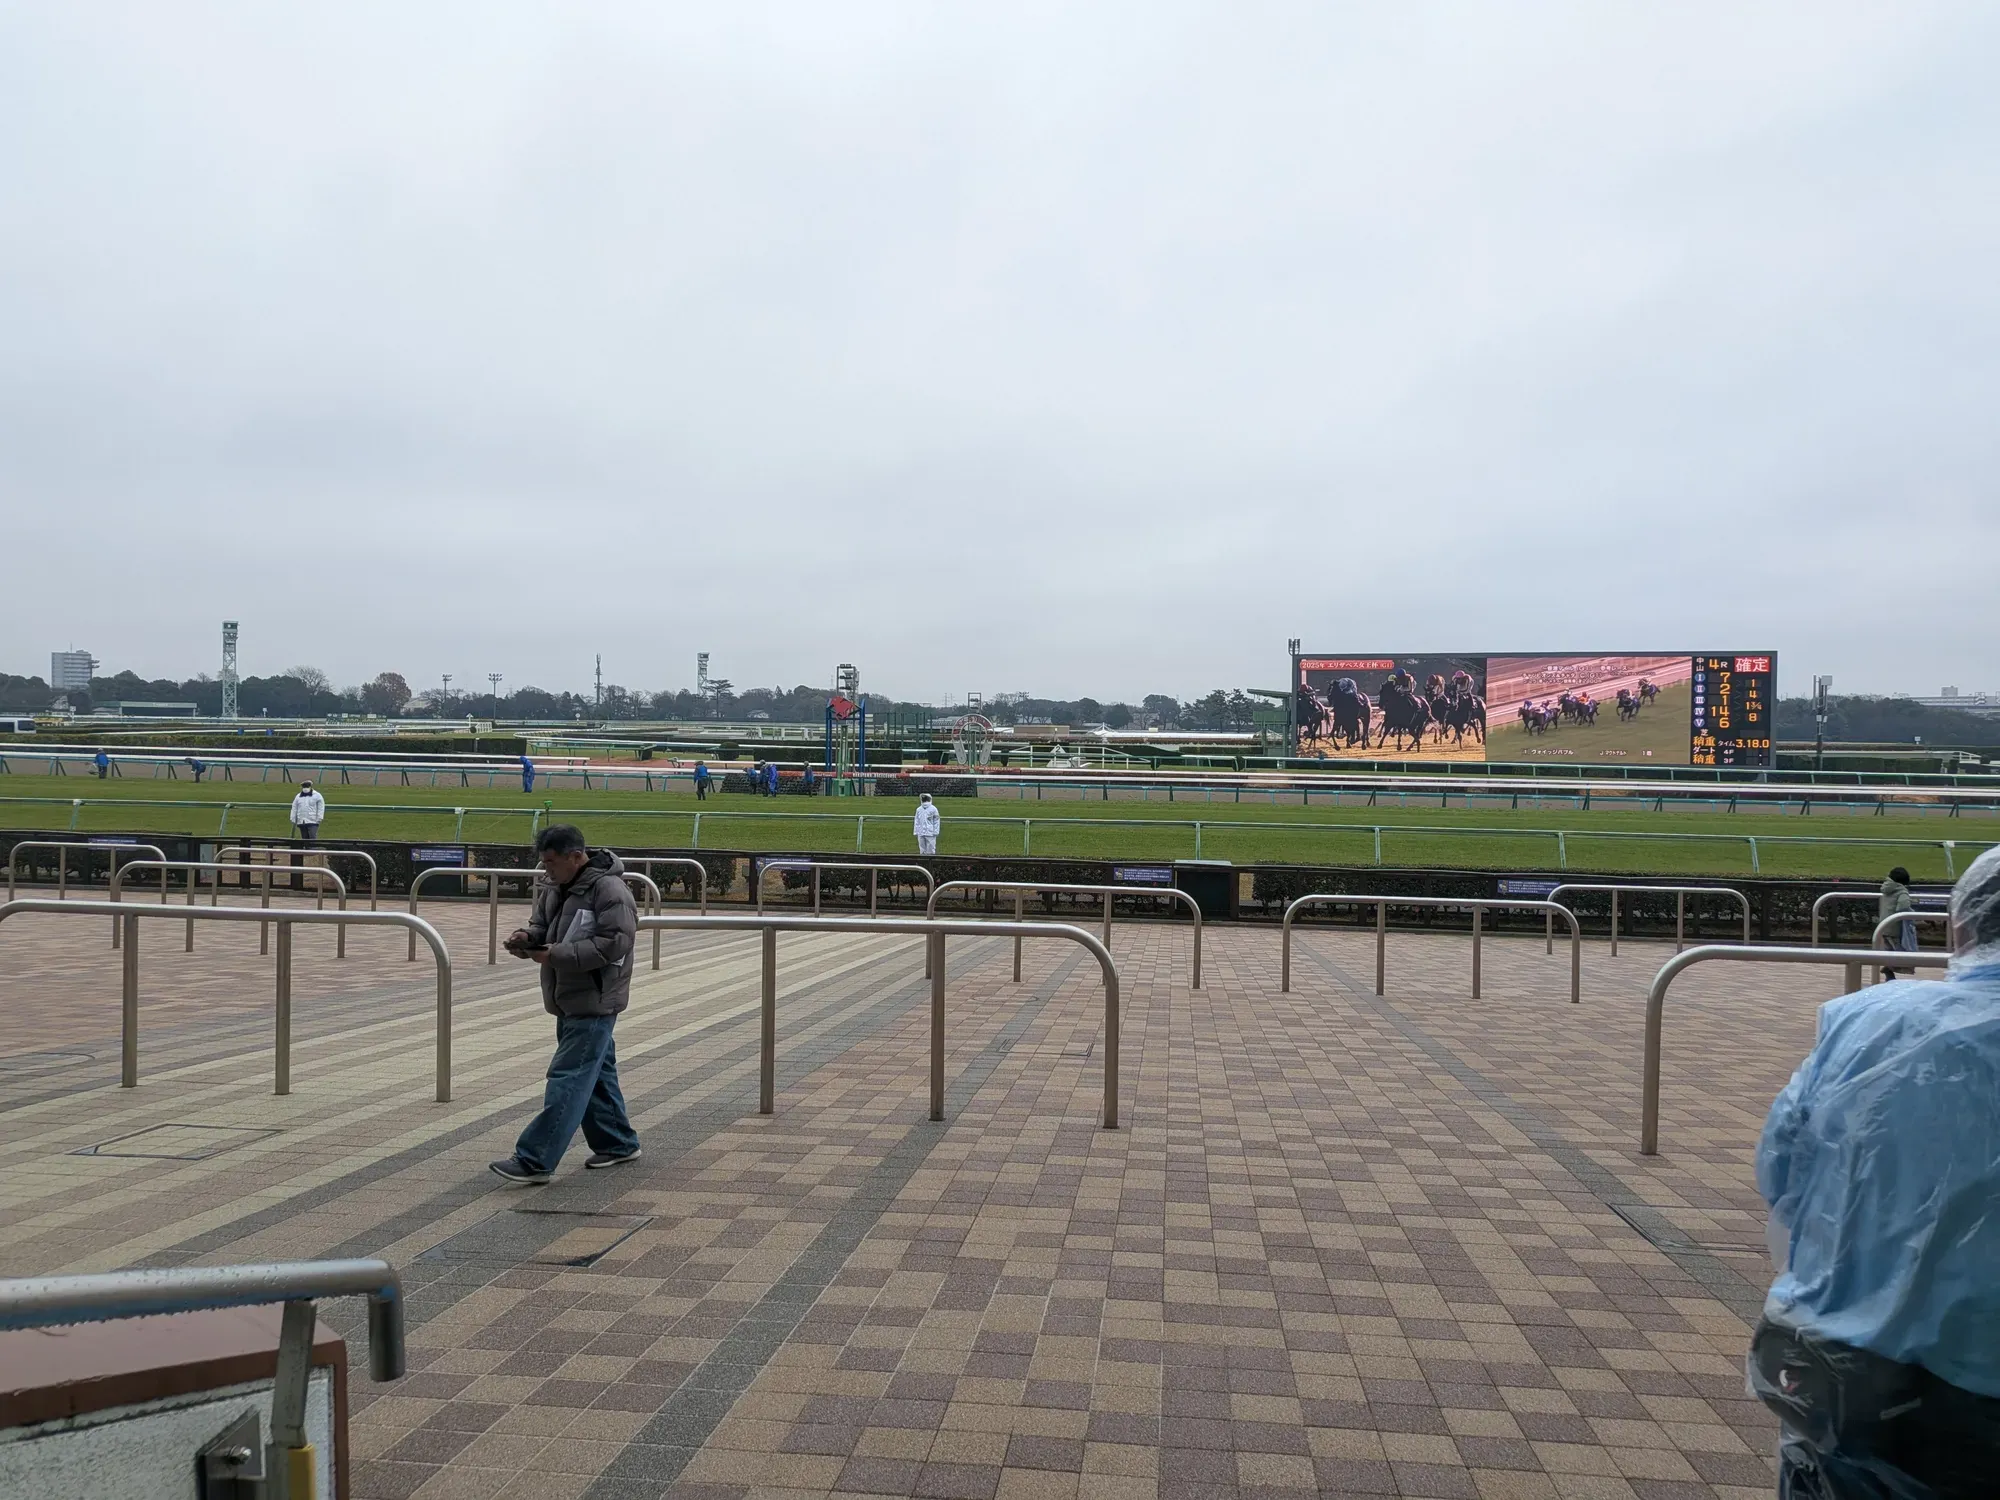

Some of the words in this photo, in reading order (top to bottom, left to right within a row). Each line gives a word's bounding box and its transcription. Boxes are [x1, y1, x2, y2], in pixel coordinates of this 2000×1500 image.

[1696, 657, 1705, 672] 中山
[1735, 657, 1768, 673] 確定
[1720, 672, 1730, 683] 7
[1720, 683, 1730, 695] 2
[1749, 690, 1757, 699] 4
[1711, 706, 1730, 717] 14
[1749, 712, 1757, 722] 8
[1719, 717, 1730, 728] 6
[1701, 728, 1709, 736] 芝
[1693, 736, 1716, 747] 稍重
[1735, 739, 1770, 748] 3.18.0
[1693, 746, 1716, 754] ダート
[1693, 753, 1716, 765] 稍重
